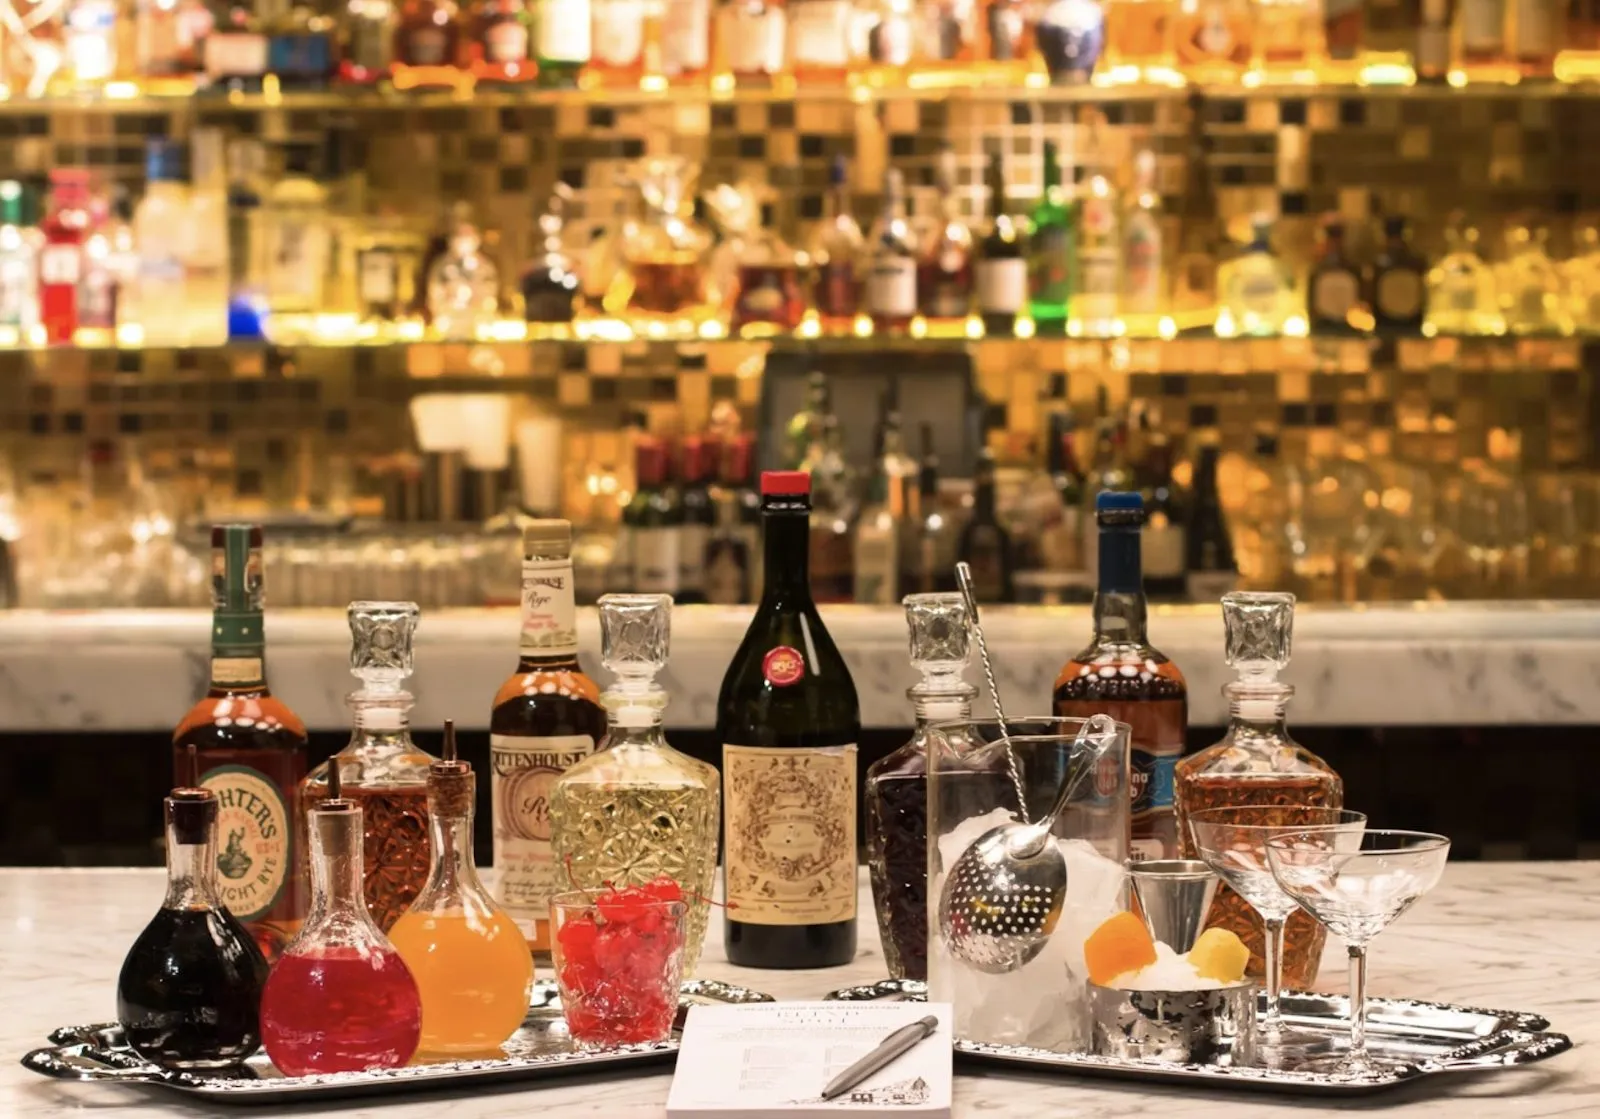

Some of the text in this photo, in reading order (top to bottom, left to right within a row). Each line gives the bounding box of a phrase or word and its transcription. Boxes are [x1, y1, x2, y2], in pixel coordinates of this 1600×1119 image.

[218, 787, 277, 839] HTER'S
[220, 857, 277, 901] IGHT RYE
